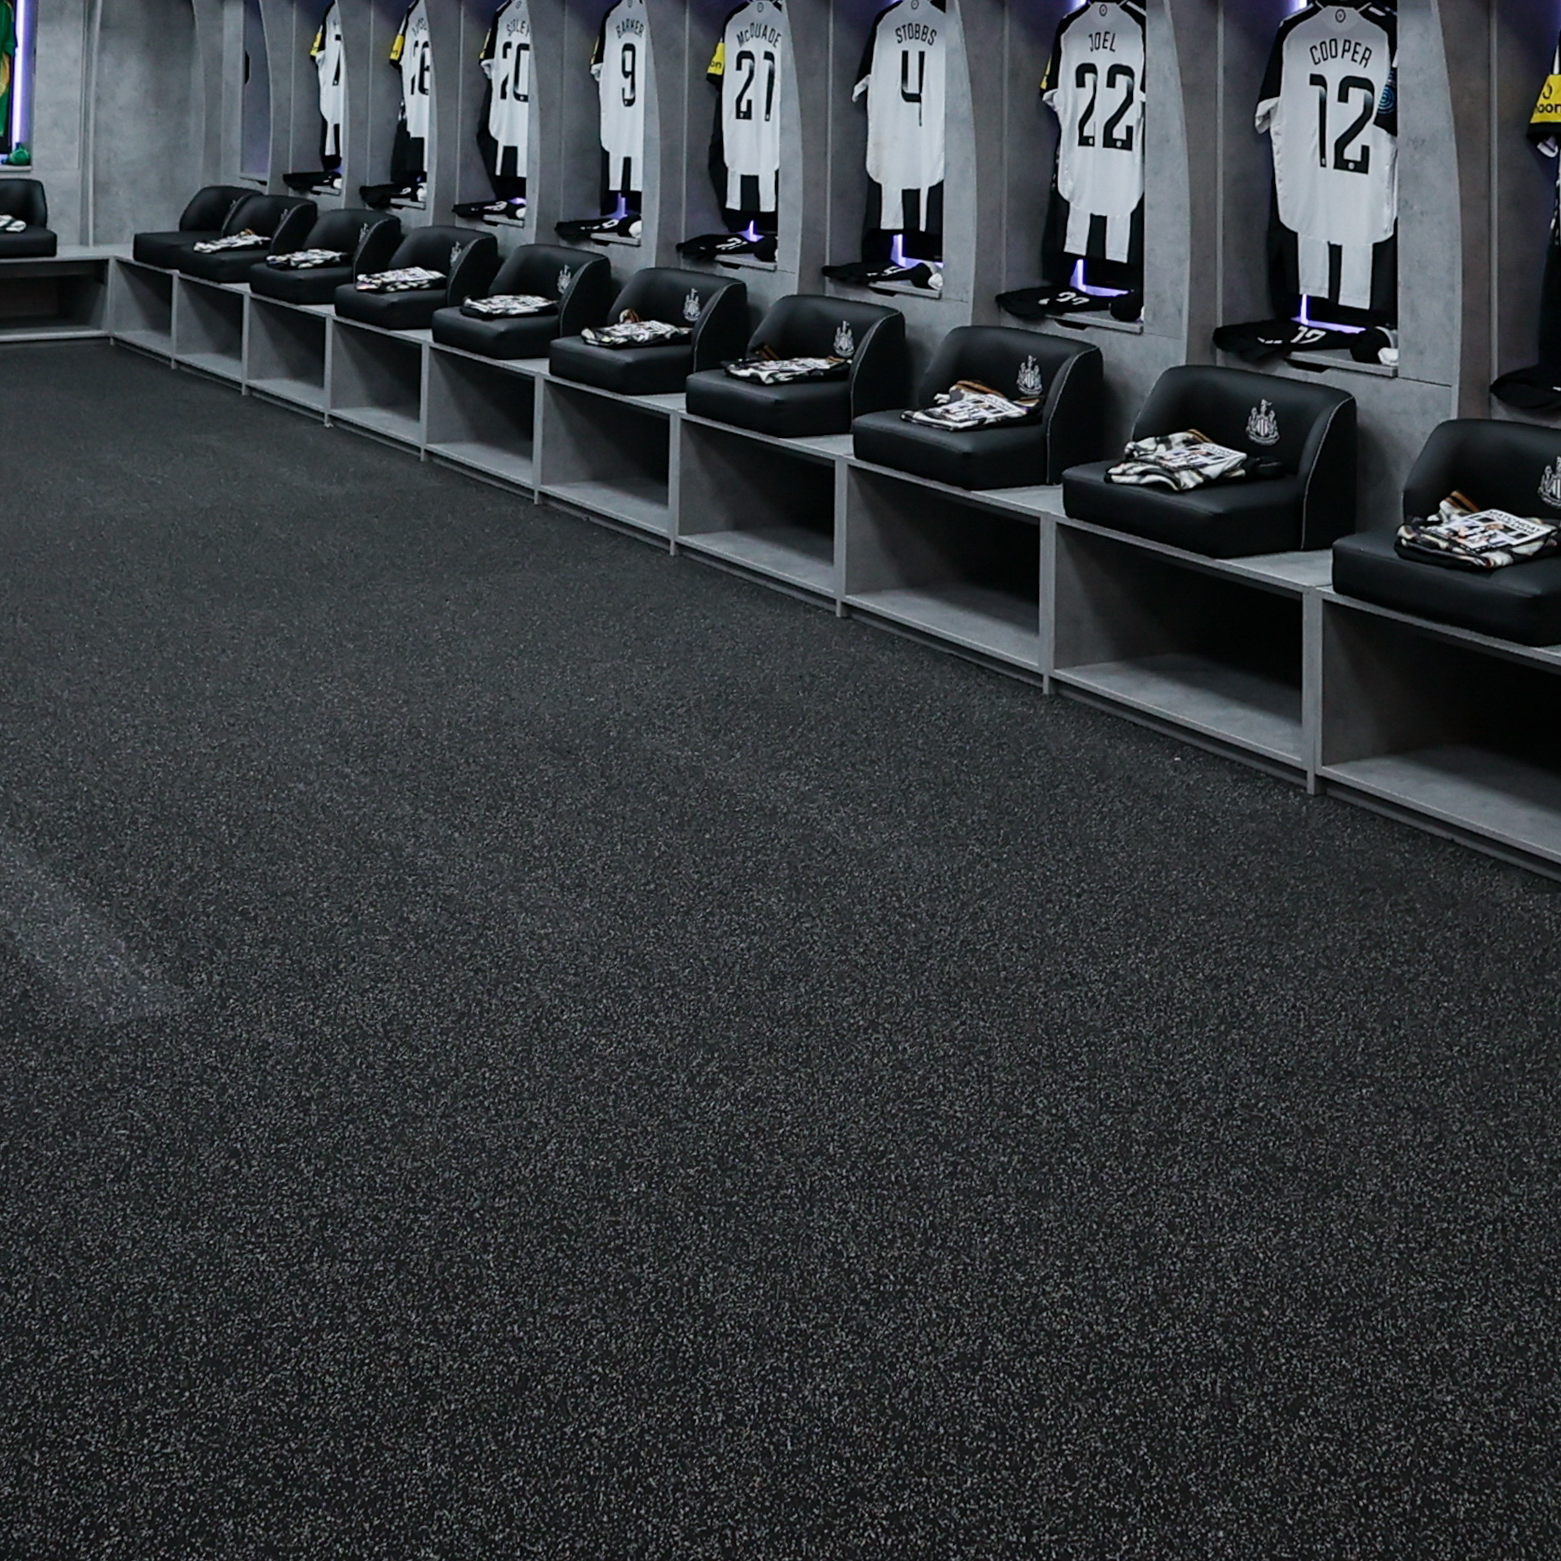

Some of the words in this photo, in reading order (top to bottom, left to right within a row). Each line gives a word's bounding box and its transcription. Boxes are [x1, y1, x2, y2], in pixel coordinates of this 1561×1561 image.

[895, 22, 937, 46] STOBBS
[1088, 31, 1117, 53] JOEL
[1309, 38, 1373, 69] COOPER
[621, 43, 636, 107] 9
[735, 50, 775, 122] 21
[901, 50, 925, 127] 4
[1075, 62, 1135, 152] 22
[1309, 73, 1375, 175] 12
